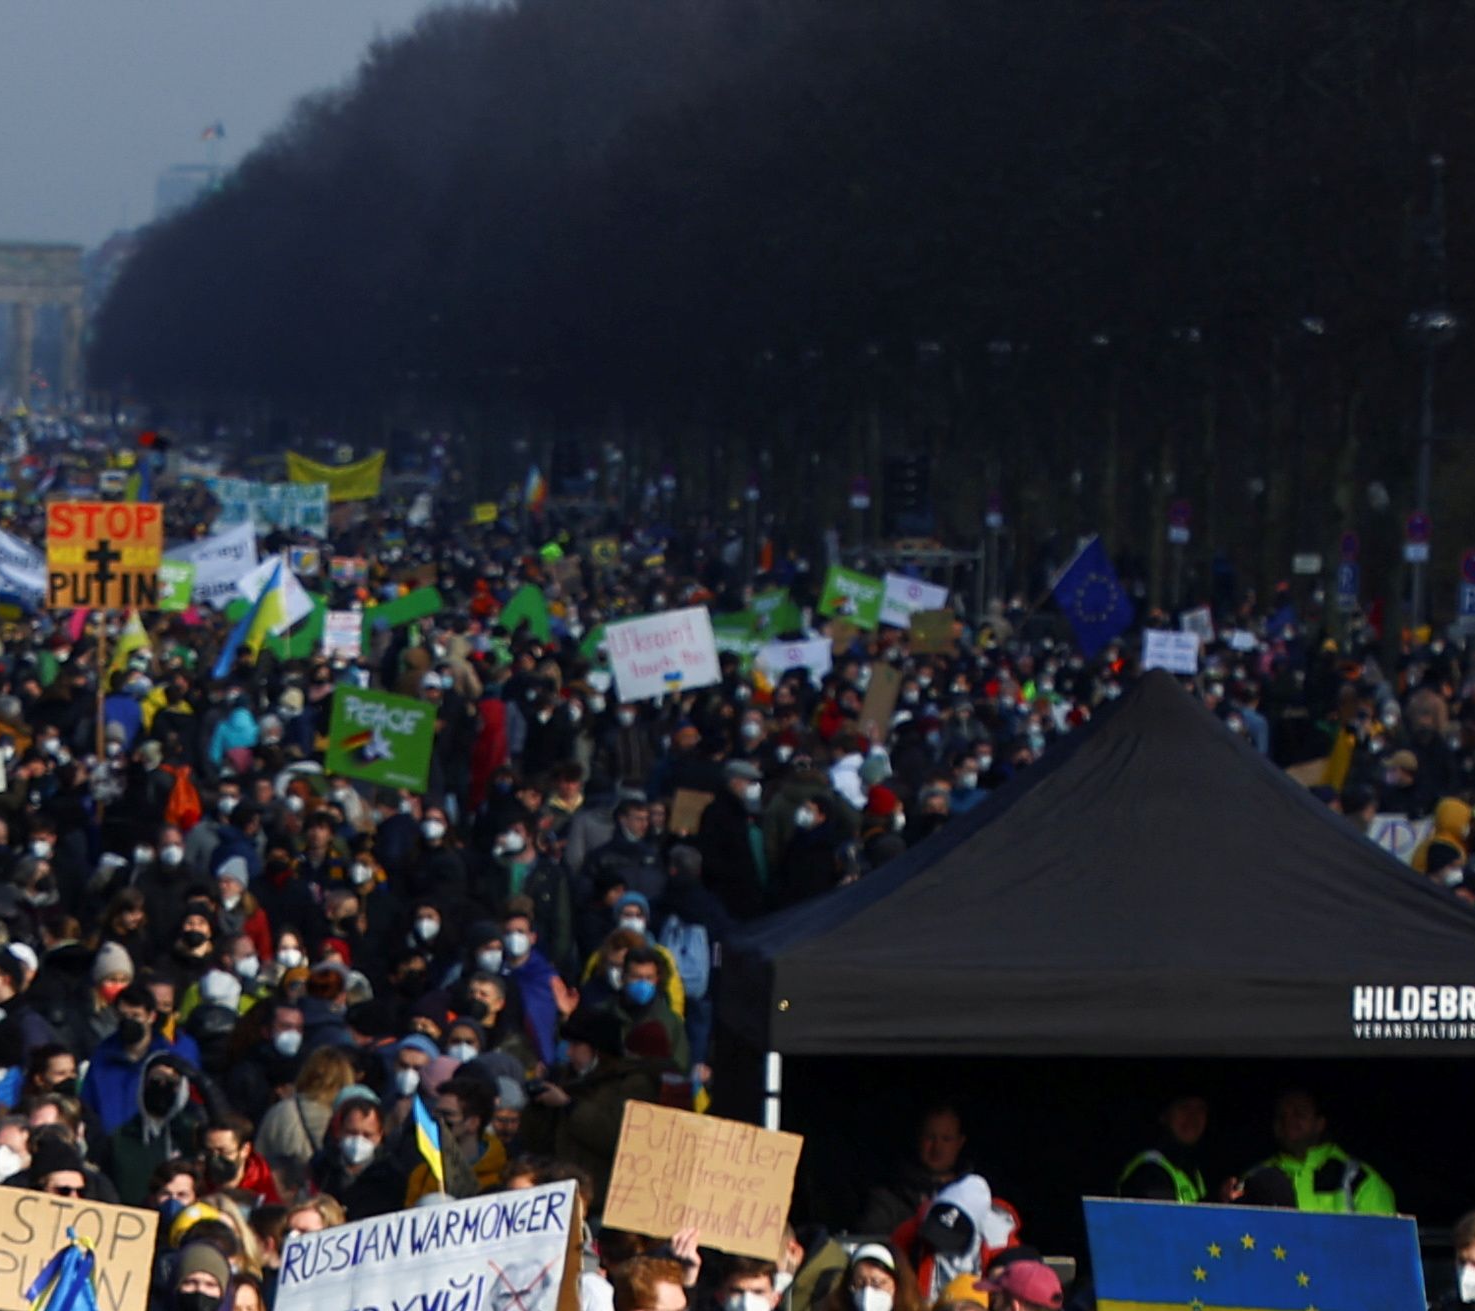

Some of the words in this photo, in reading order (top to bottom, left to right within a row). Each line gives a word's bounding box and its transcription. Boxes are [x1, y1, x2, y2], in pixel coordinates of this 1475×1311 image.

[49, 504, 158, 540] STOP
[344, 696, 426, 735] PEACE
[617, 1151, 653, 1176] no
[2, 1195, 147, 1261] STOP
[280, 1216, 405, 1286] RUSSIAN
[409, 1191, 568, 1256] WARMONGER
